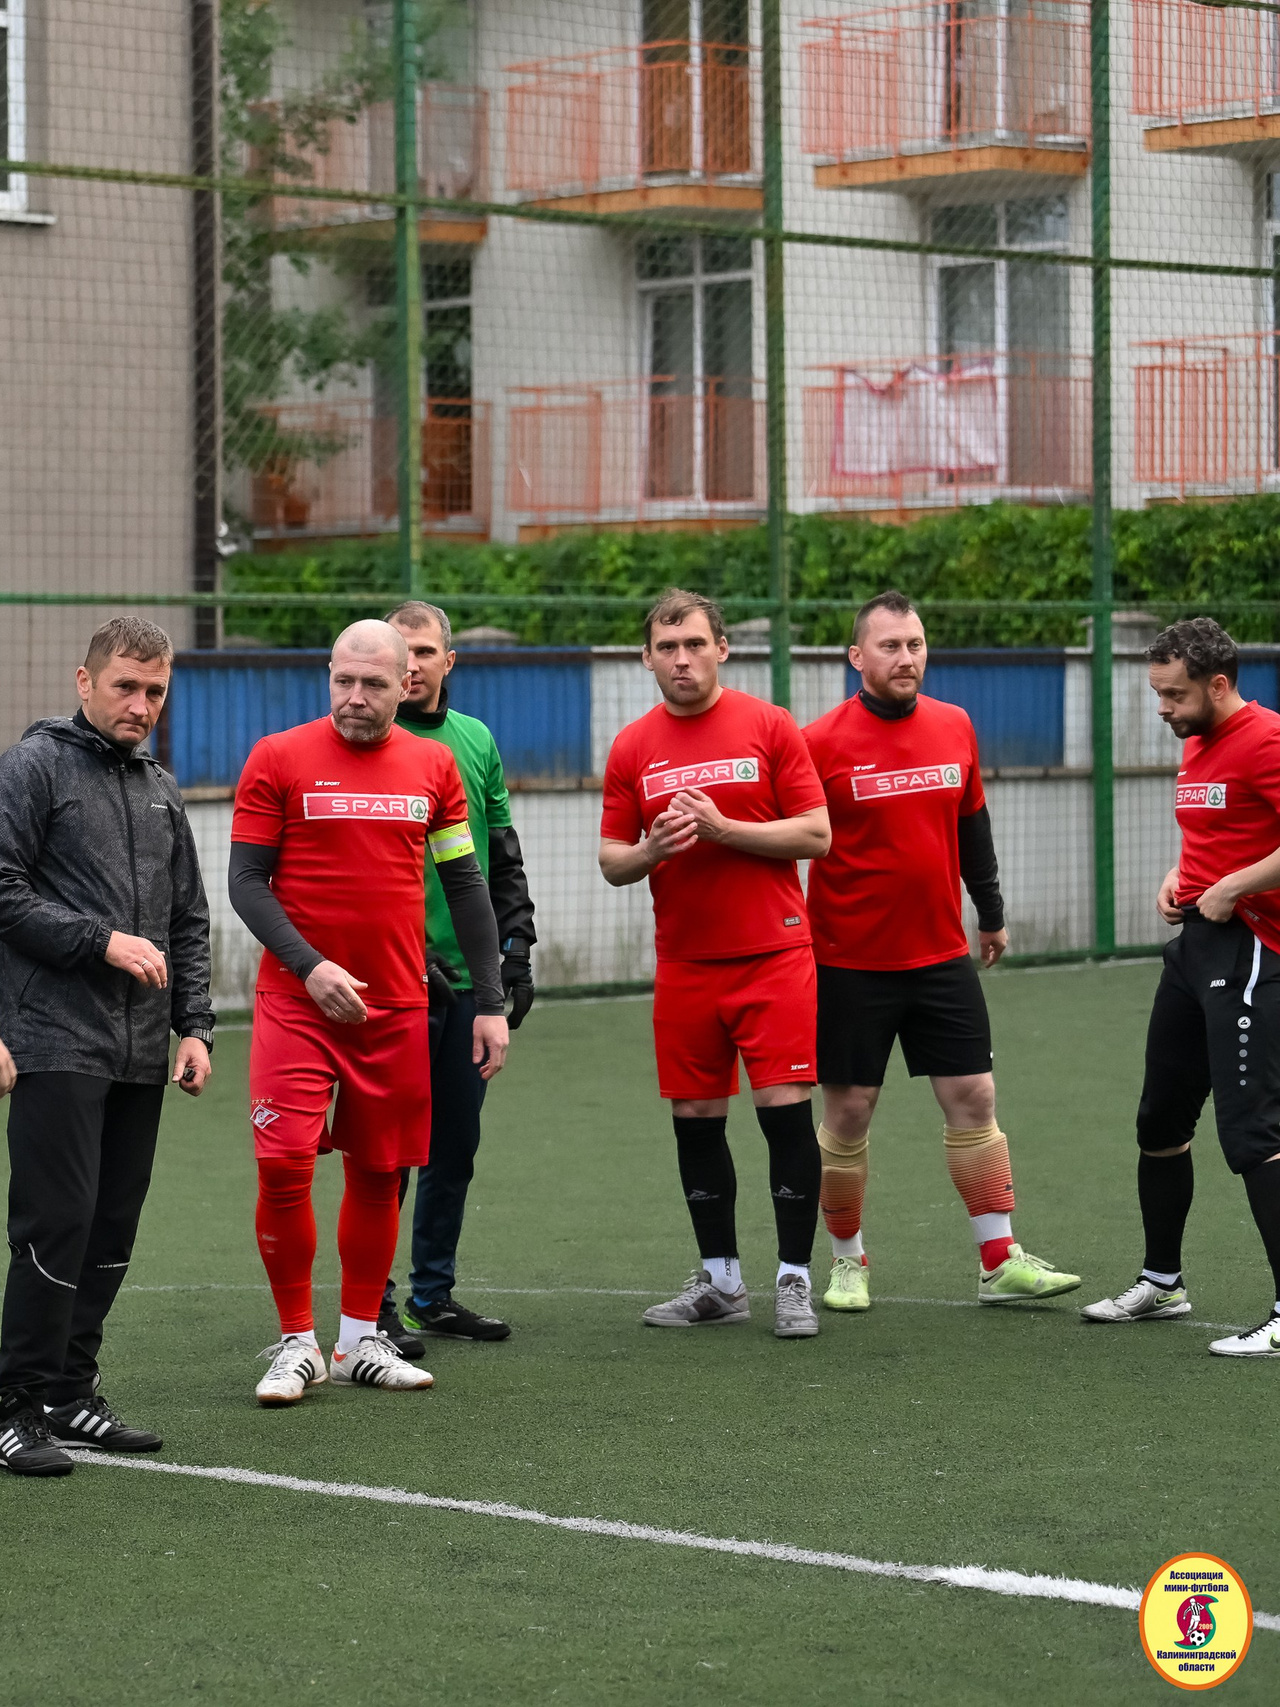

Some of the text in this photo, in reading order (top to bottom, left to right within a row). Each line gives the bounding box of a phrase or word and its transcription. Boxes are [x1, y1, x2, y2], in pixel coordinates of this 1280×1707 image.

[663, 765, 730, 788] SPAR
[876, 771, 940, 791] SPAR
[1176, 789, 1206, 803] SPAR
[331, 799, 405, 814] SPAR
